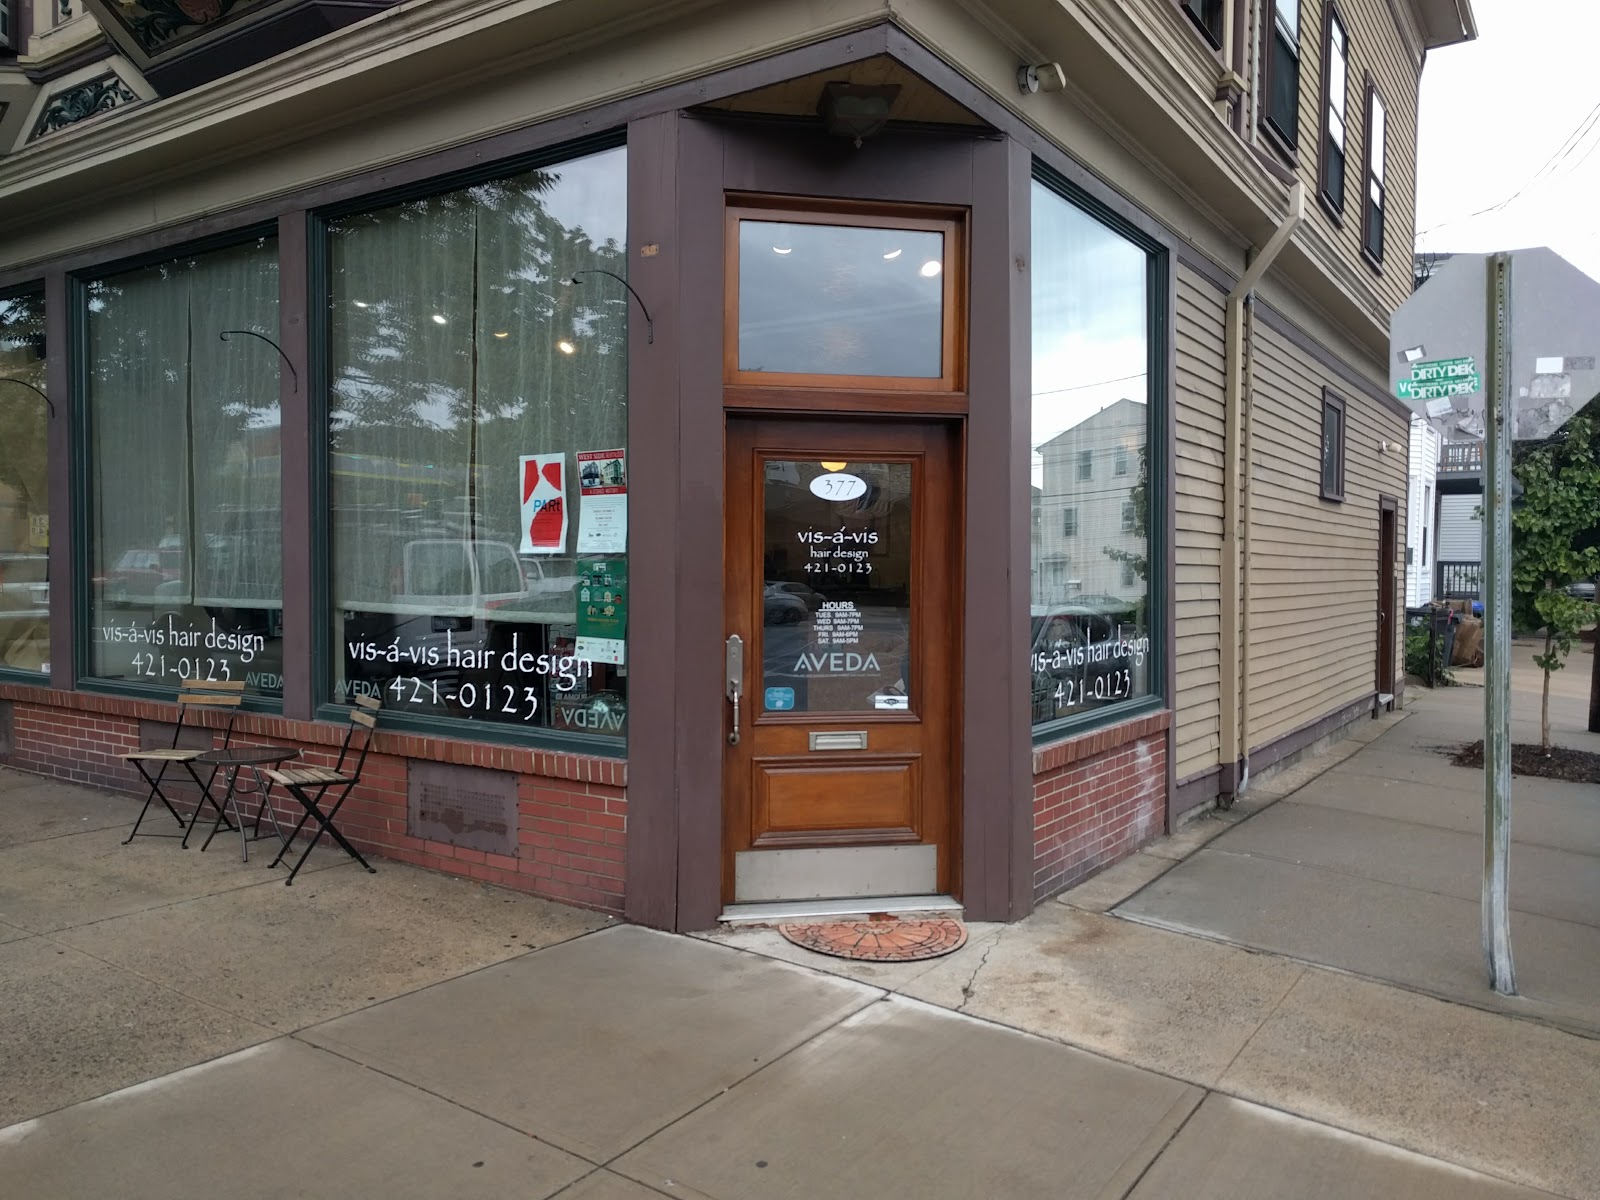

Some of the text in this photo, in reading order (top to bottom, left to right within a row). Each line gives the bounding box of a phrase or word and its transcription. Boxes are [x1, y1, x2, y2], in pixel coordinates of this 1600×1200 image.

[1411, 366, 1446, 381] DIRTY
[1447, 363, 1475, 377] DEK
[1411, 385, 1446, 400] DIRTY
[1447, 382, 1475, 396] DEK
[824, 479, 856, 496] 377
[810, 546, 868, 562] hair design
[804, 563, 872, 574] 421-0123
[822, 601, 854, 609] HOURS
[169, 615, 201, 648] hair
[205, 617, 264, 663] design
[1087, 626, 1111, 663] hair
[1113, 624, 1149, 666] design
[132, 652, 230, 682] 421-0123
[447, 628, 495, 670] hair
[501, 632, 592, 691] design
[794, 653, 880, 672] AVEDA
[245, 671, 283, 689] AVEDA
[334, 679, 382, 698] AVEDA
[1054, 669, 1130, 709] 421-0123
[389, 675, 537, 720] 421-0123
